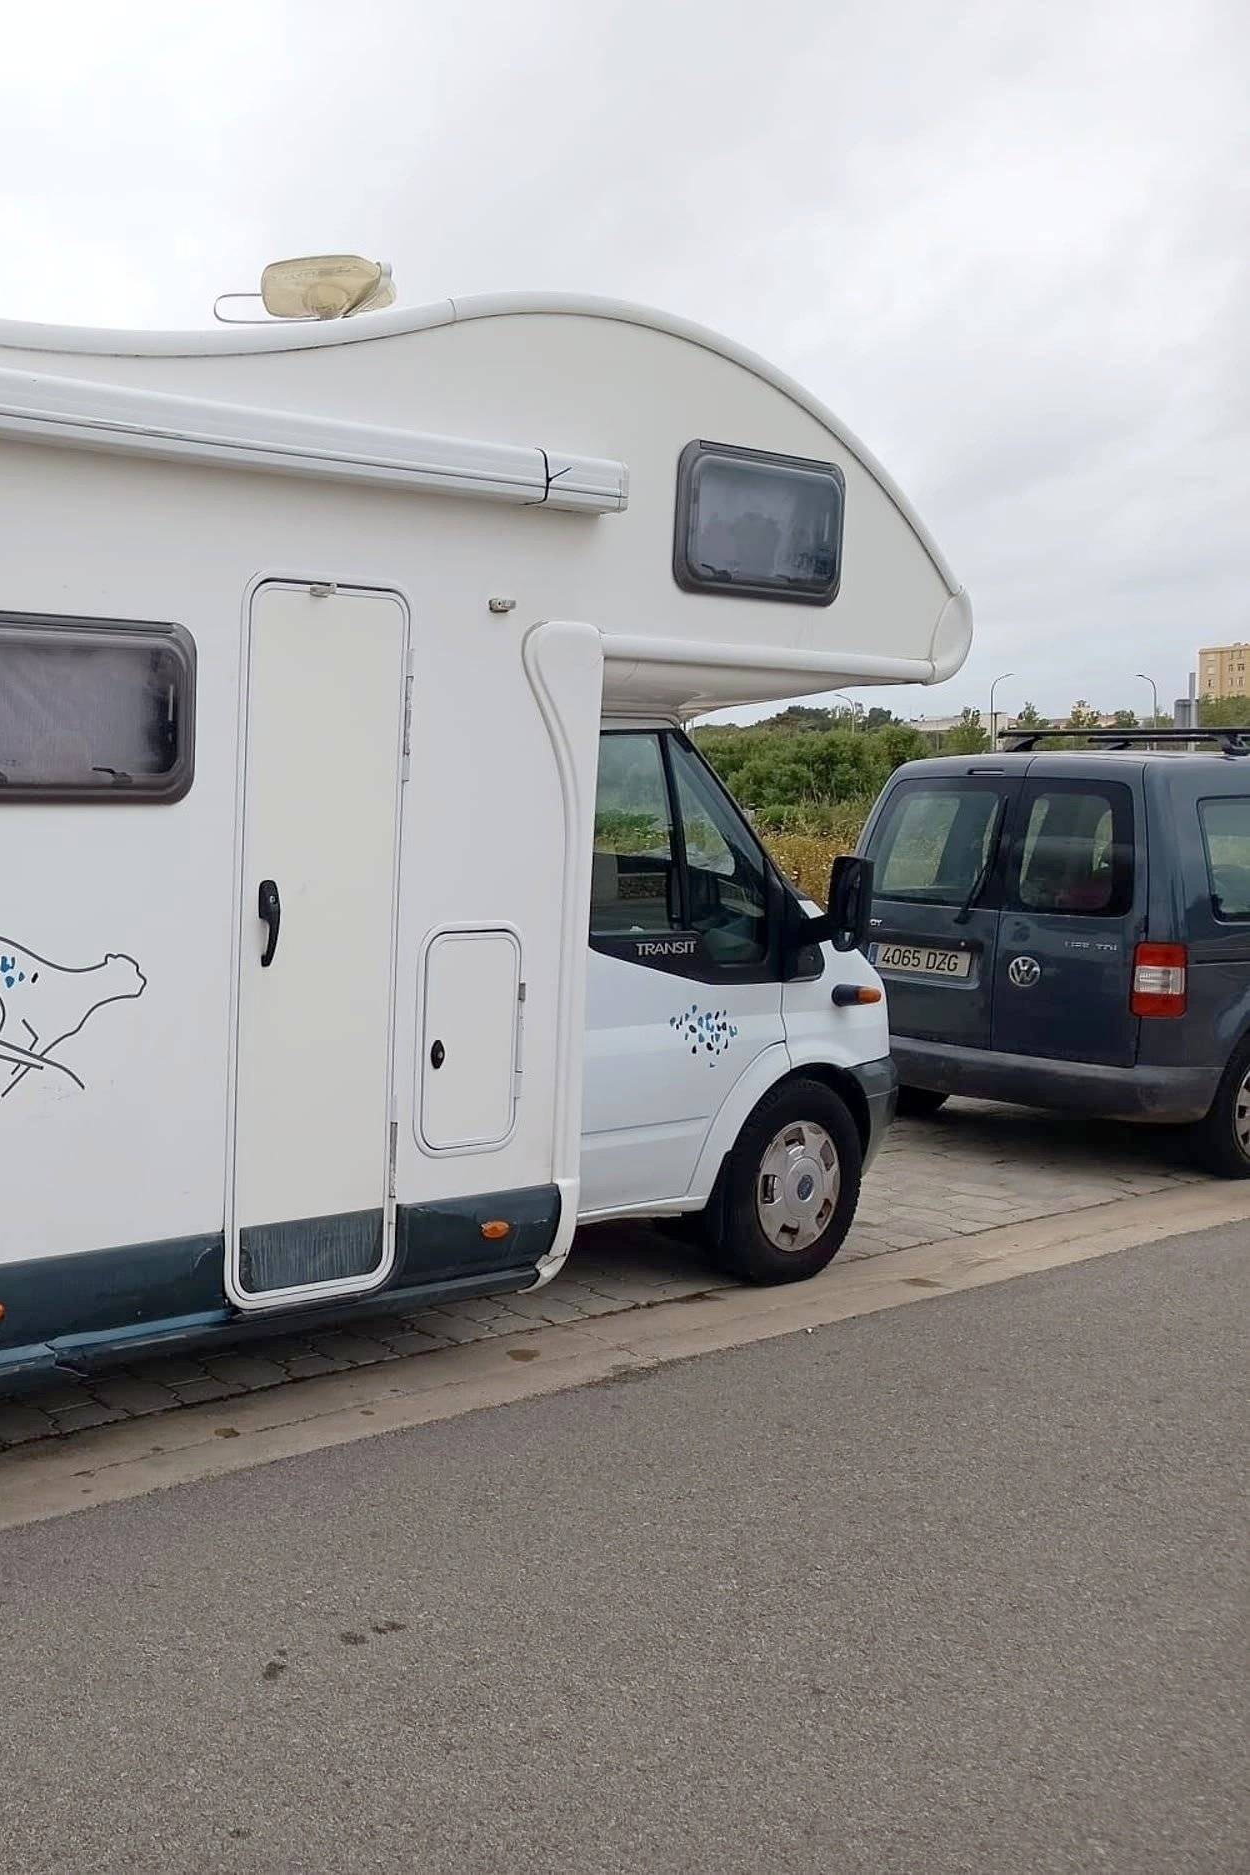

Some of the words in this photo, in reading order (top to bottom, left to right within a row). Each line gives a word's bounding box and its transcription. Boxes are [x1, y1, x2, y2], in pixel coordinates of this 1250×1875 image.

[635, 940, 697, 956] TRANSIT
[881, 947, 922, 968] 4065
[925, 951, 959, 972] DZG
